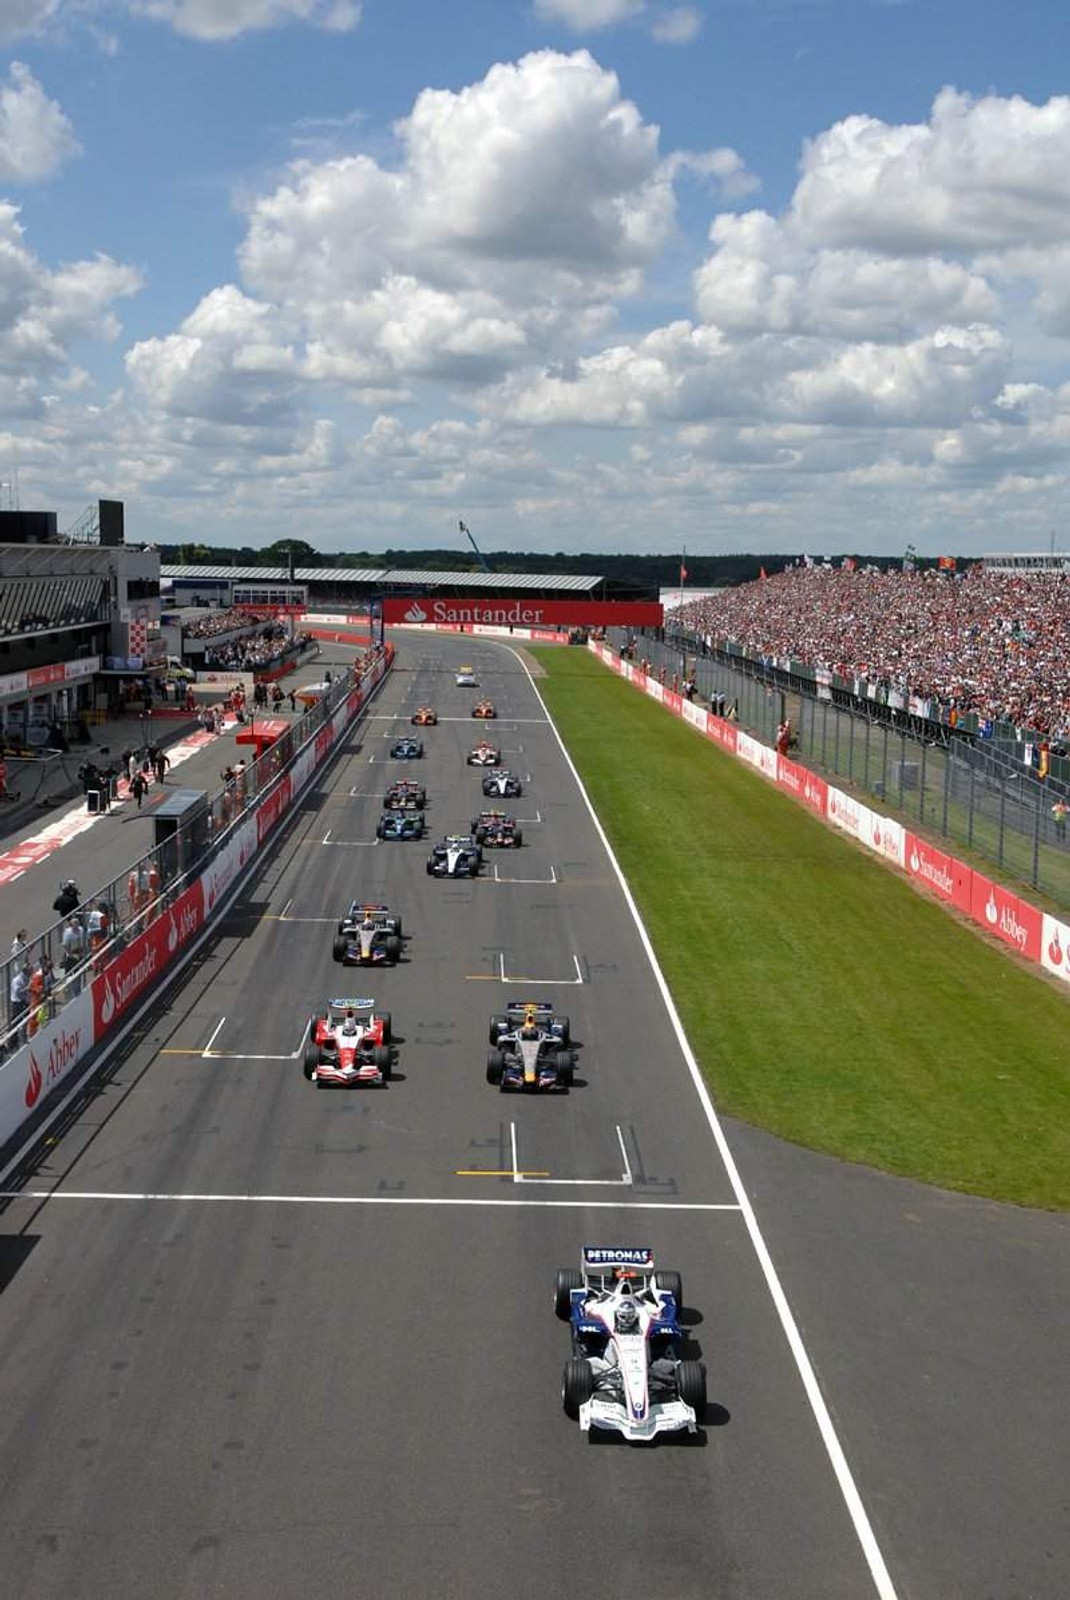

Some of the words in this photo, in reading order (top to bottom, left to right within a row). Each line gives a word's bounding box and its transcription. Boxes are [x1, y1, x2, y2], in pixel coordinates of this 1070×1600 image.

[433, 601, 544, 623] Santander
[920, 851, 953, 894] Santander
[999, 904, 1028, 952] Abbey
[116, 941, 157, 1009] Santander
[179, 904, 198, 942] Abbey
[46, 1028, 82, 1088] Abbey
[587, 1249, 648, 1262] PETRONAS
